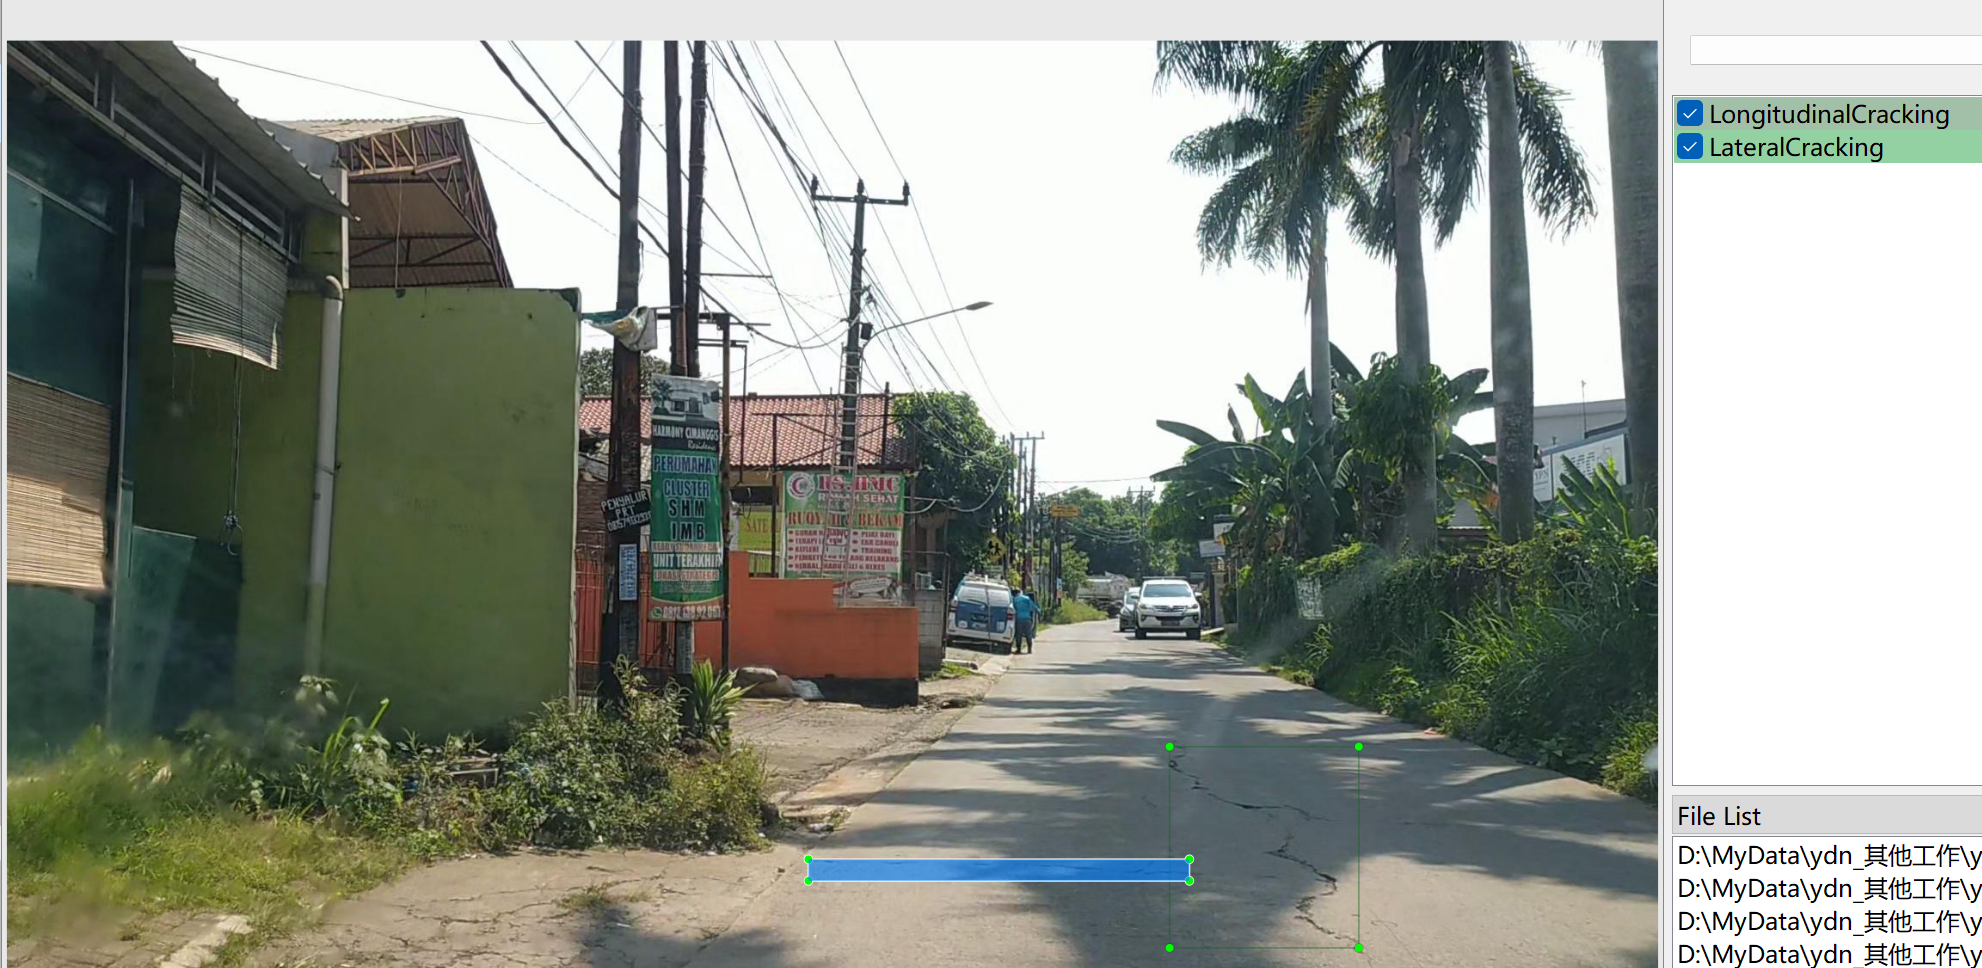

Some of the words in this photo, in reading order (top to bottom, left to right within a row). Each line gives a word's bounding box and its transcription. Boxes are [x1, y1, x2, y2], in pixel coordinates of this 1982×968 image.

[1710, 104, 1950, 130] LongitudinalCracking
[1710, 136, 1884, 163] LateralCracking
[652, 425, 684, 438] HARMONY
[663, 478, 711, 499] CLUSTER
[601, 490, 648, 512] PENYALUR
[863, 494, 899, 504] SEHAT
[615, 505, 636, 520] PRT
[653, 553, 675, 568] UNIT
[1678, 806, 1716, 826] File
[1724, 806, 1762, 826] List
[1678, 943, 1982, 968] D:\MyData\ydn其他工作\y
